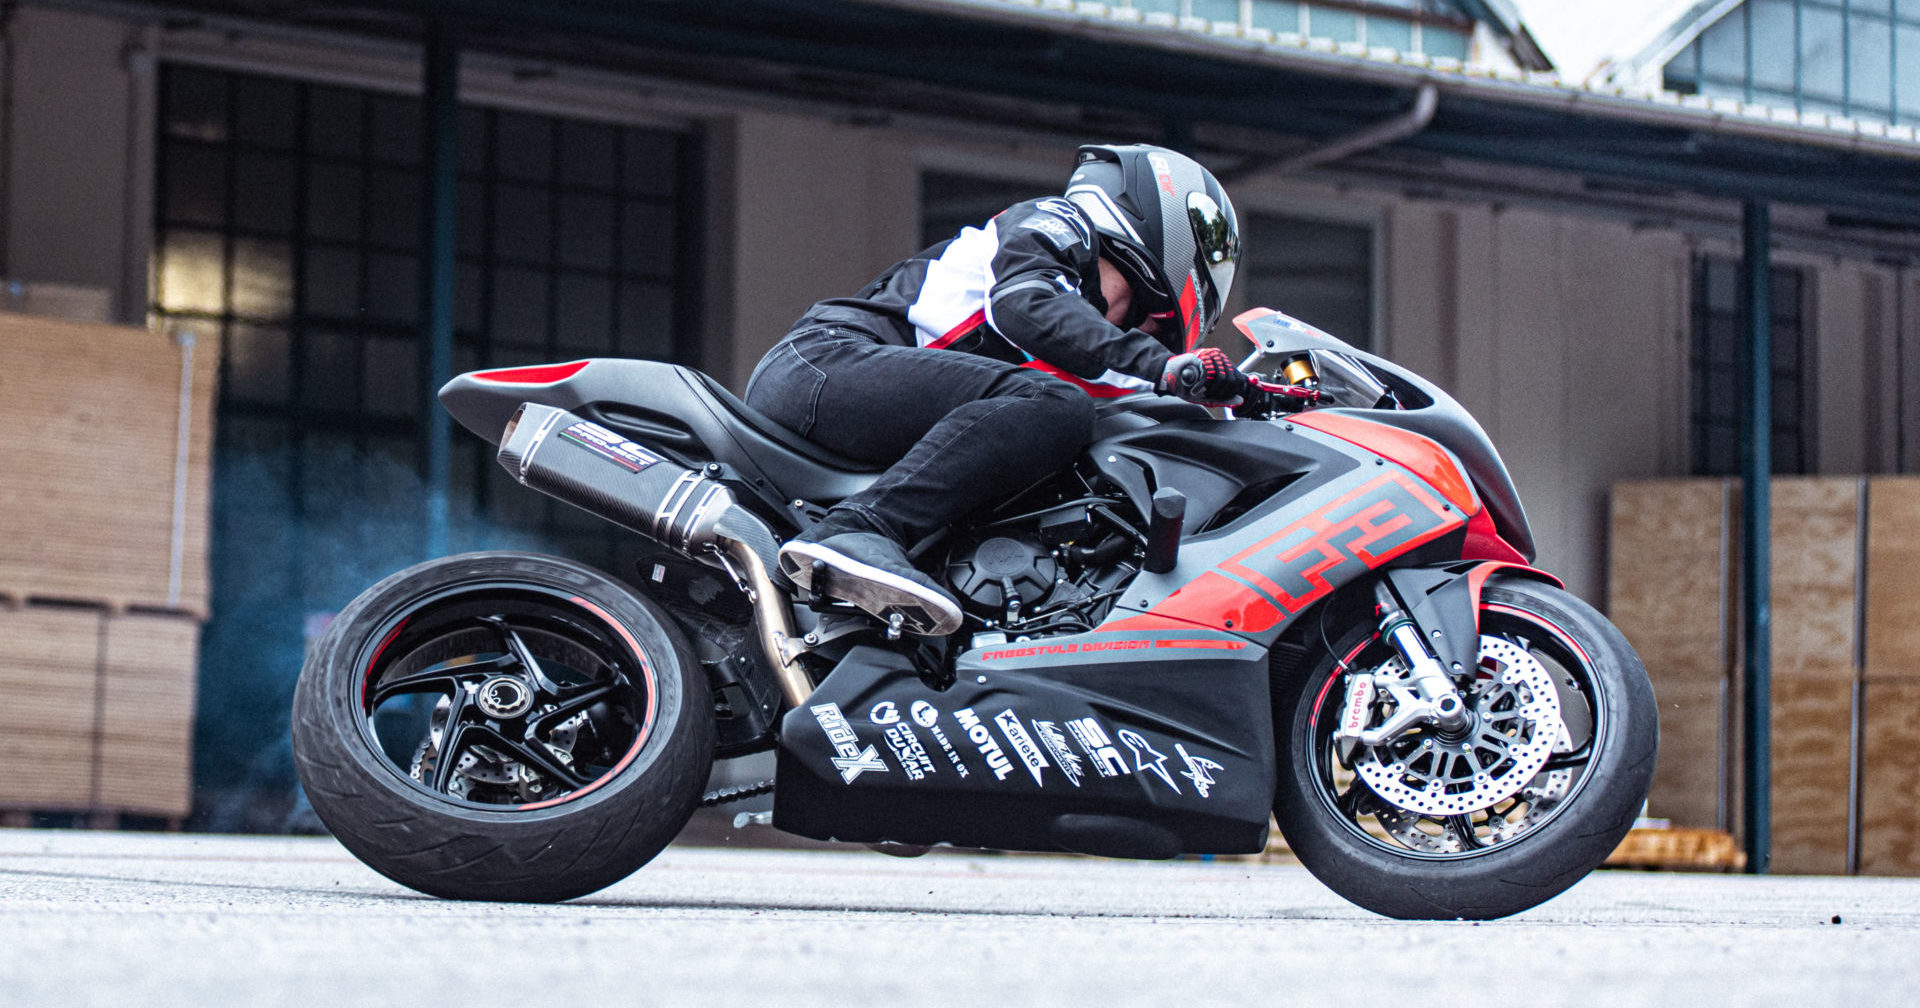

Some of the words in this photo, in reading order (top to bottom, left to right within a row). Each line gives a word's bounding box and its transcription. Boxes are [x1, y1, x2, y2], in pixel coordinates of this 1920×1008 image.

[567, 425, 650, 467] PROJECT
[573, 418, 670, 464] SC
[1082, 639, 1150, 652] DIVISION
[1348, 681, 1367, 727] brembo
[810, 702, 890, 785] RideX
[896, 721, 936, 773] CIRCUIT
[931, 726, 950, 753] MADE
[946, 750, 962, 766] IN
[954, 761, 970, 779] OX
[953, 708, 1013, 781] MOTUL
[1010, 727, 1040, 768] ariete
[1067, 721, 1112, 777] PROJECT
[1073, 717, 1131, 778] SC
